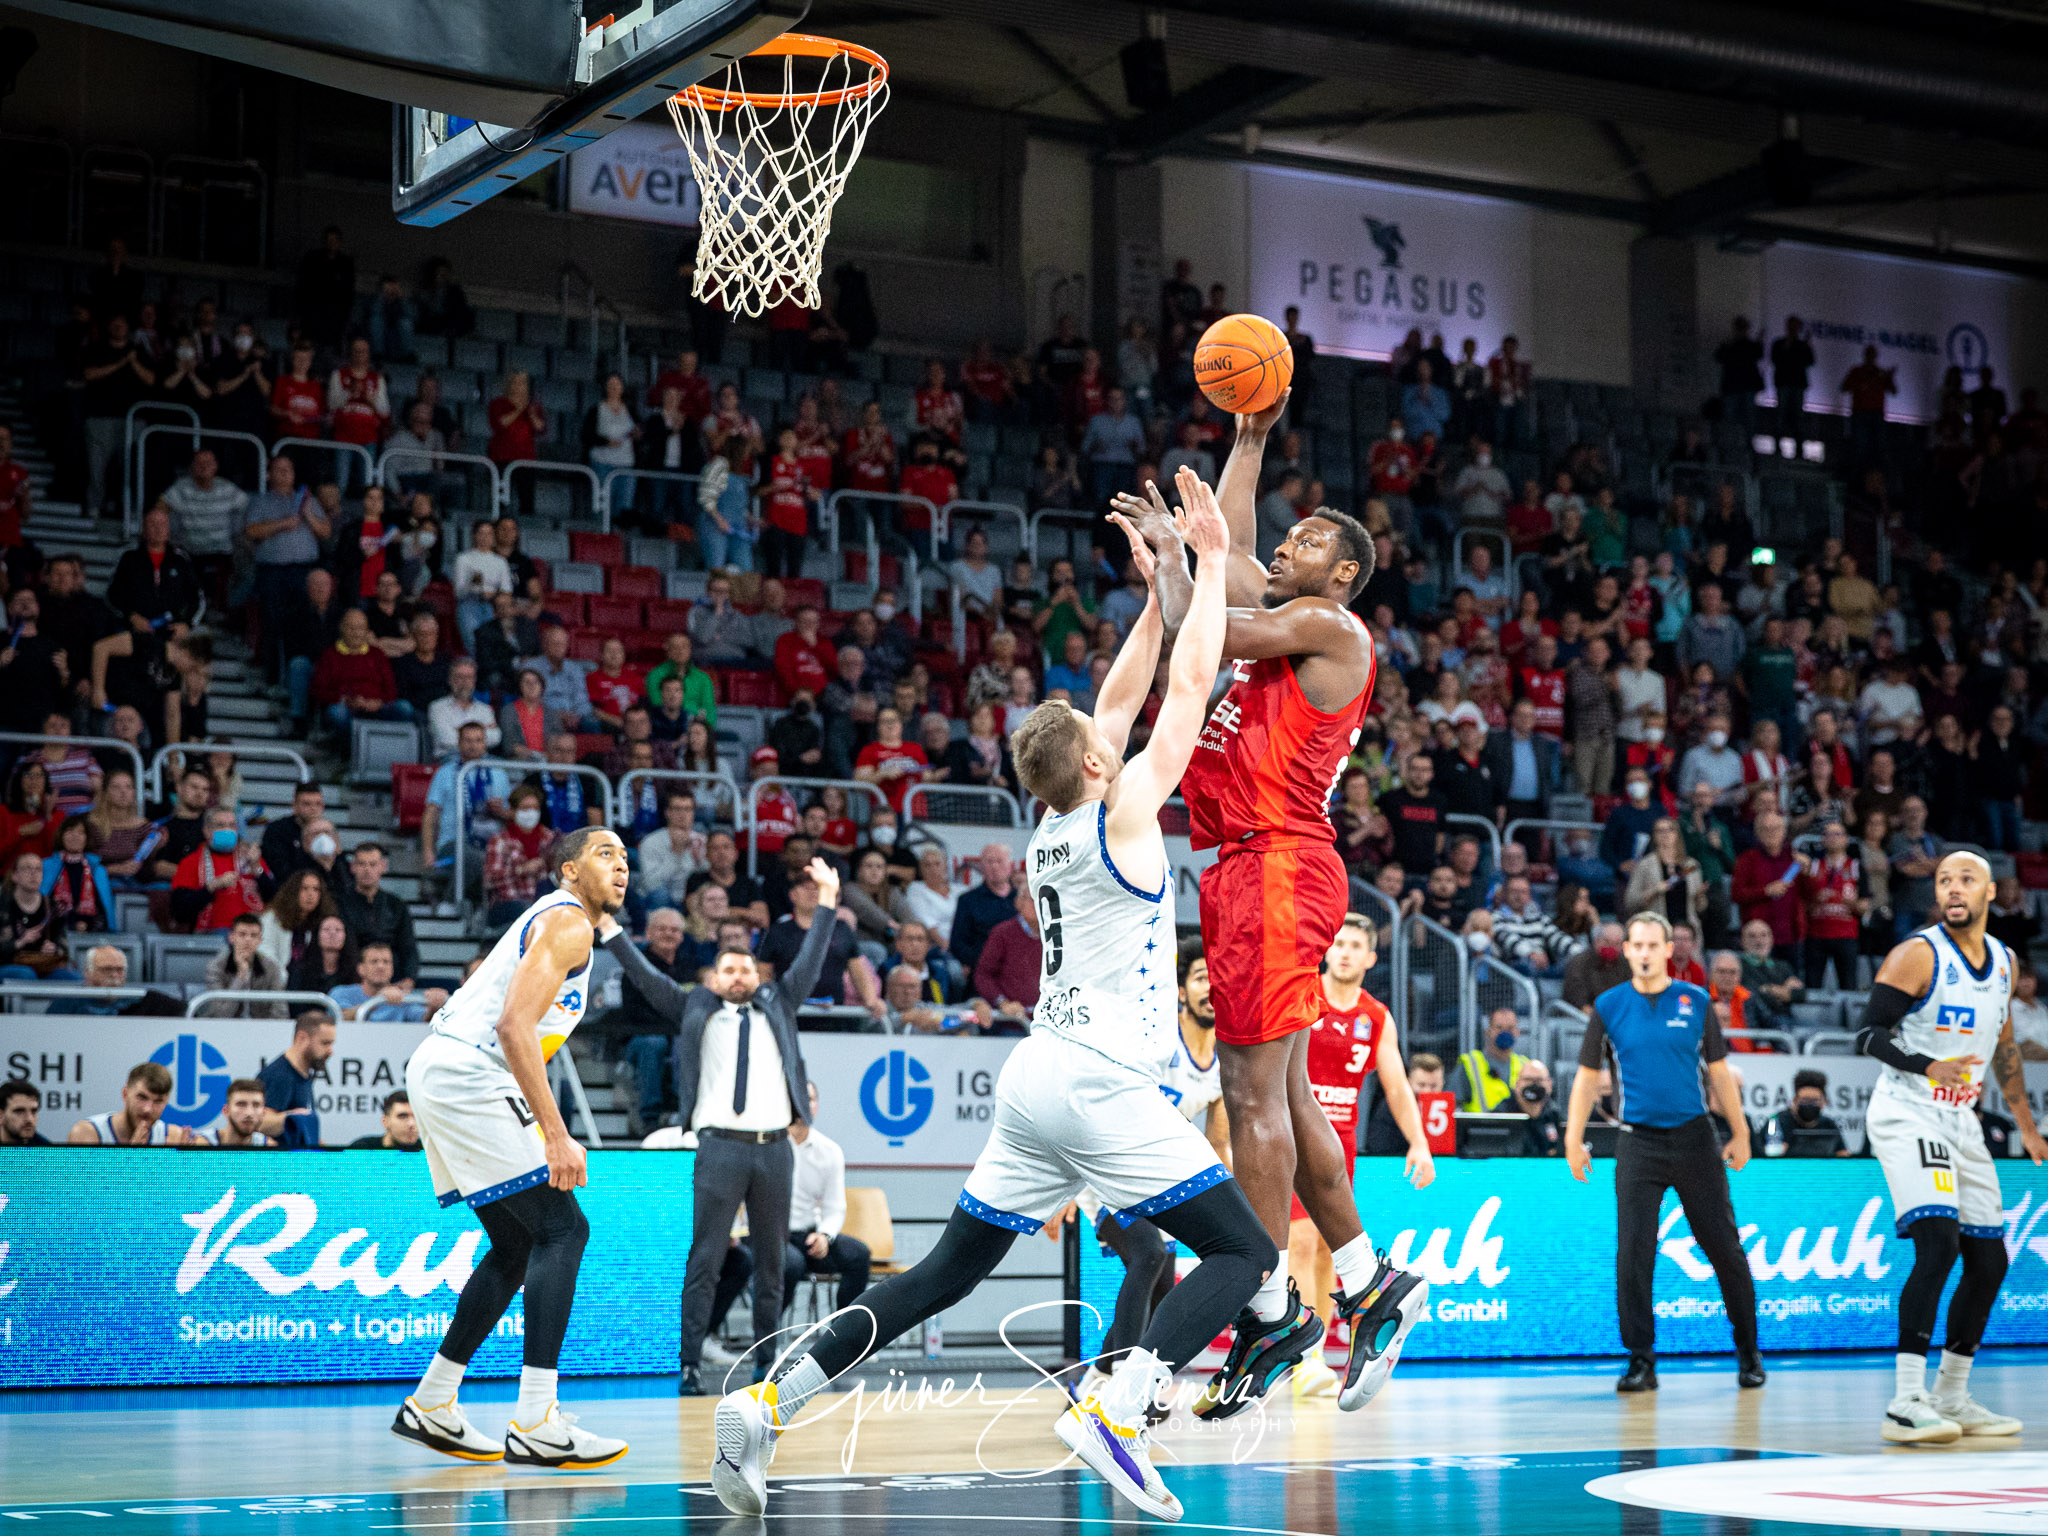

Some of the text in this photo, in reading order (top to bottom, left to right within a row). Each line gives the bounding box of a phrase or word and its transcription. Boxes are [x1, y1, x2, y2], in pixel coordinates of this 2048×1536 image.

[1299, 260, 1486, 320] PEGASUS
[1344, 1043, 1371, 1073] 3
[957, 1069, 992, 1098] IG
[175, 1185, 484, 1298] Rau
[1436, 1297, 1508, 1322] GmbH
[1753, 1294, 1823, 1322] ogistik
[1827, 1293, 1892, 1315] GmbH
[178, 1315, 318, 1347] Spedition
